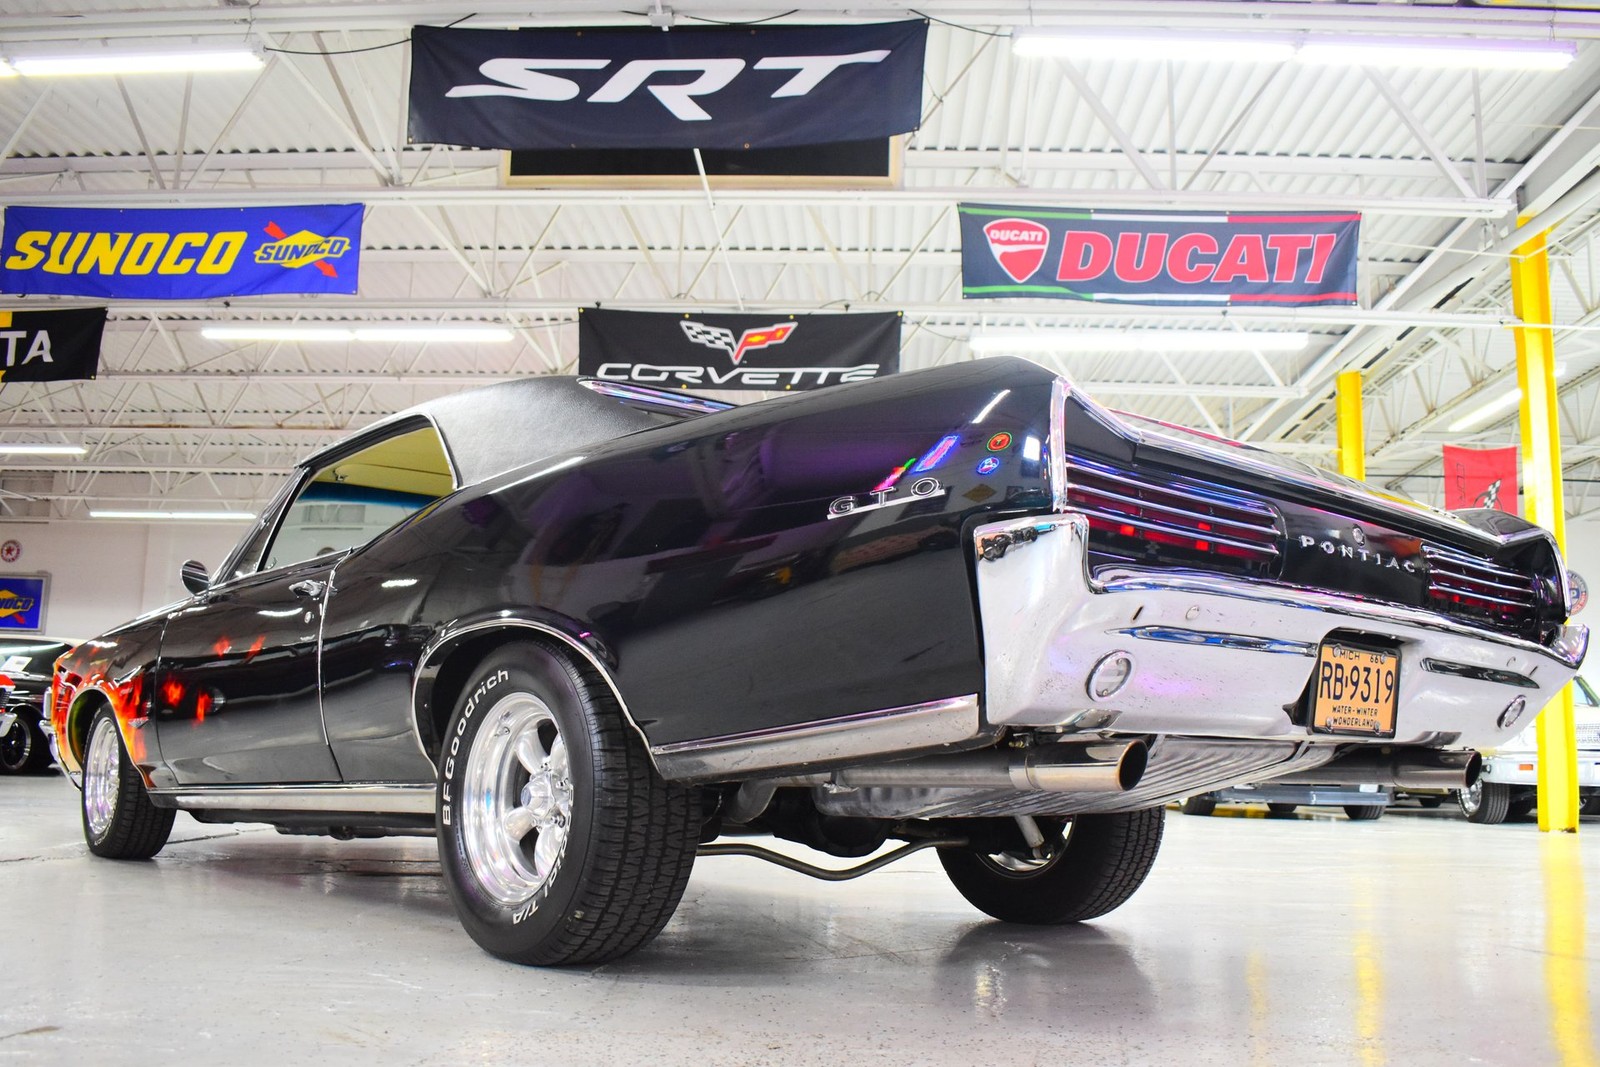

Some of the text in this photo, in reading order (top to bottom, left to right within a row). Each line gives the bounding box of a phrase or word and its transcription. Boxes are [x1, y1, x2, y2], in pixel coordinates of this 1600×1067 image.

[445, 50, 891, 121] SRT
[5, 231, 248, 275] SUNOCO
[257, 239, 346, 262] SUNOCO
[989, 229, 1043, 242] DUCATI
[1056, 231, 1336, 283] DUCATI
[597, 363, 880, 384] CORVETTE
[829, 477, 943, 516] GTO
[1299, 534, 1416, 573] PONTIAC
[1340, 650, 1361, 661] MICH
